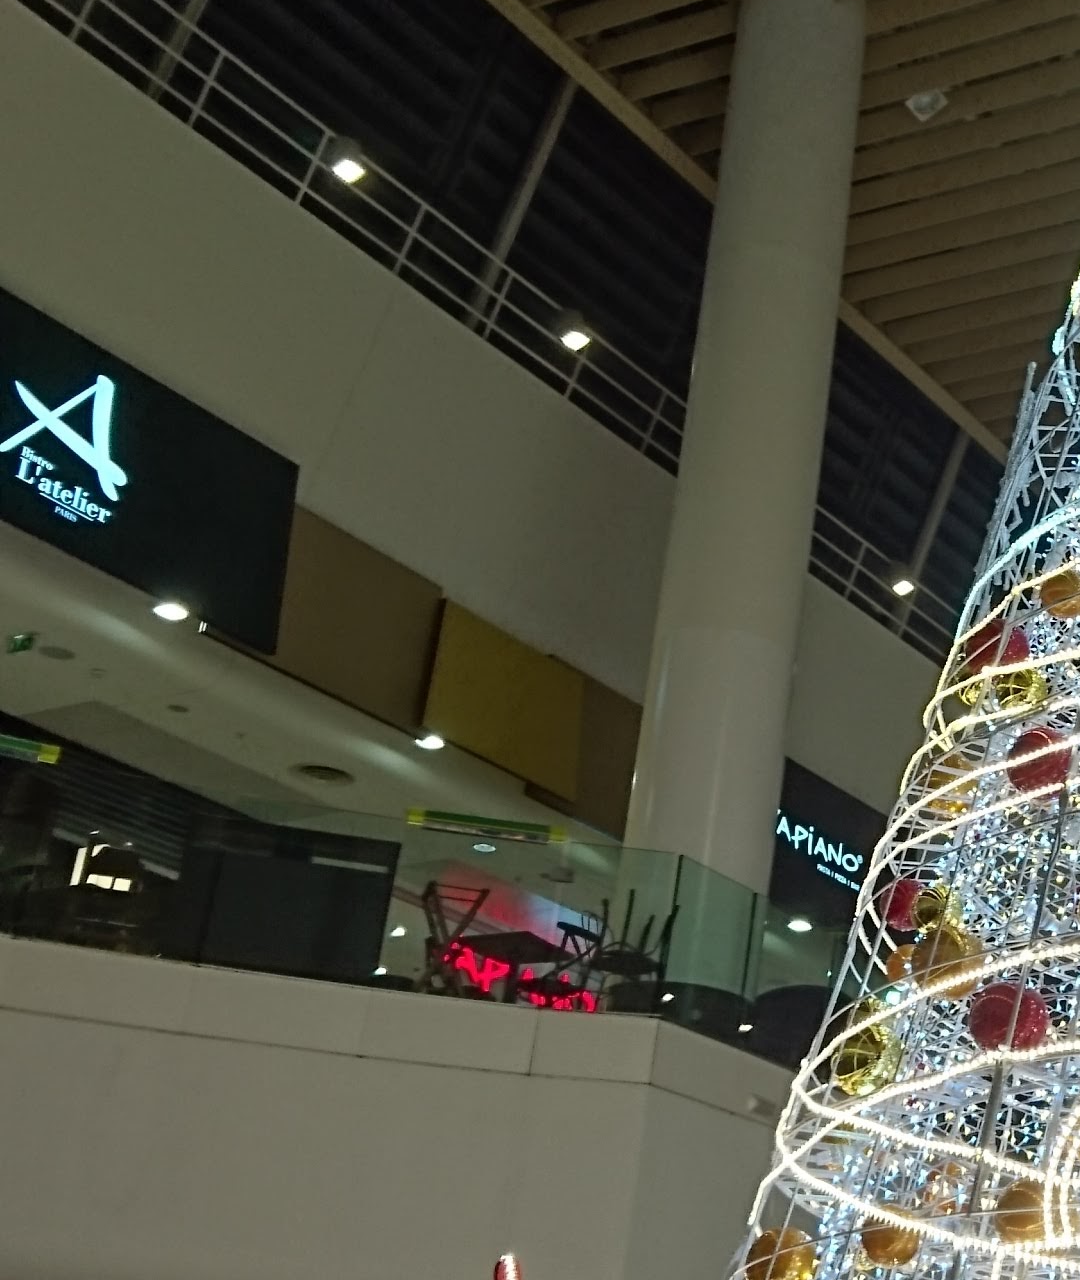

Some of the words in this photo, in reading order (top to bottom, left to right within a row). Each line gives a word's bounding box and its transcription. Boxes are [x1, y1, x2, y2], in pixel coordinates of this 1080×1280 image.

[21, 446, 55, 471] Bistro
[15, 456, 112, 523] L'atelier
[54, 505, 78, 523] PARIS
